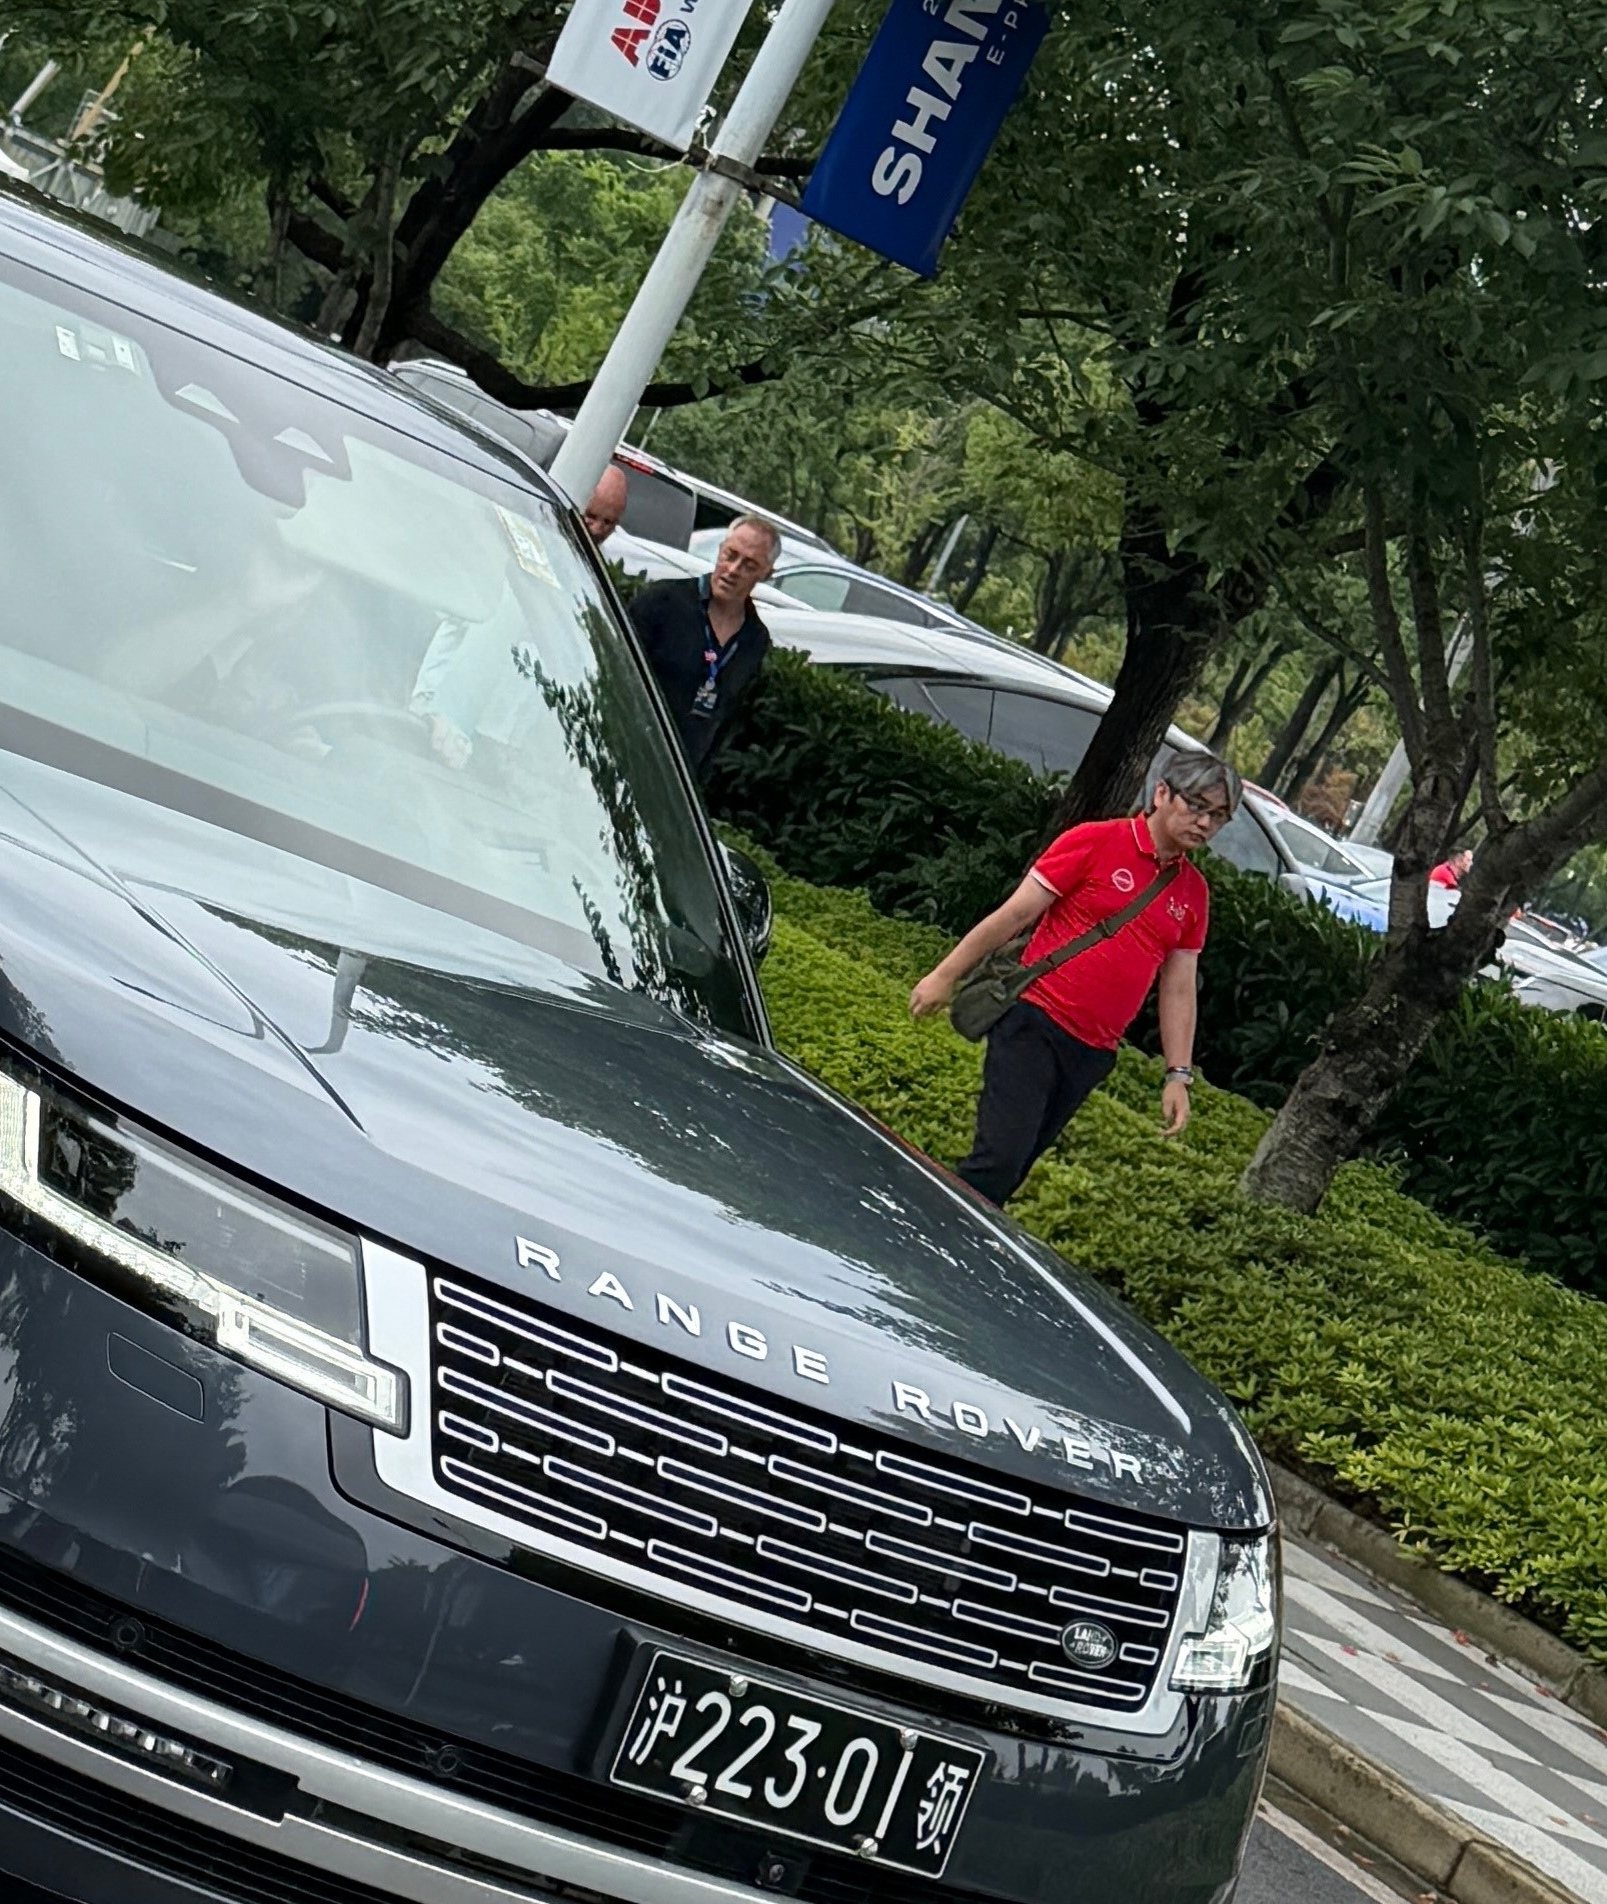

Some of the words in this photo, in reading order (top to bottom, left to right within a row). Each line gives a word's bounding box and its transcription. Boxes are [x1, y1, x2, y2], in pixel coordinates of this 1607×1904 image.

[514, 1234, 831, 1386] RANGE
[892, 1379, 1146, 1484] ROVER
[1074, 1627, 1102, 1642] LAND
[1074, 1641, 1108, 1657] ROVER
